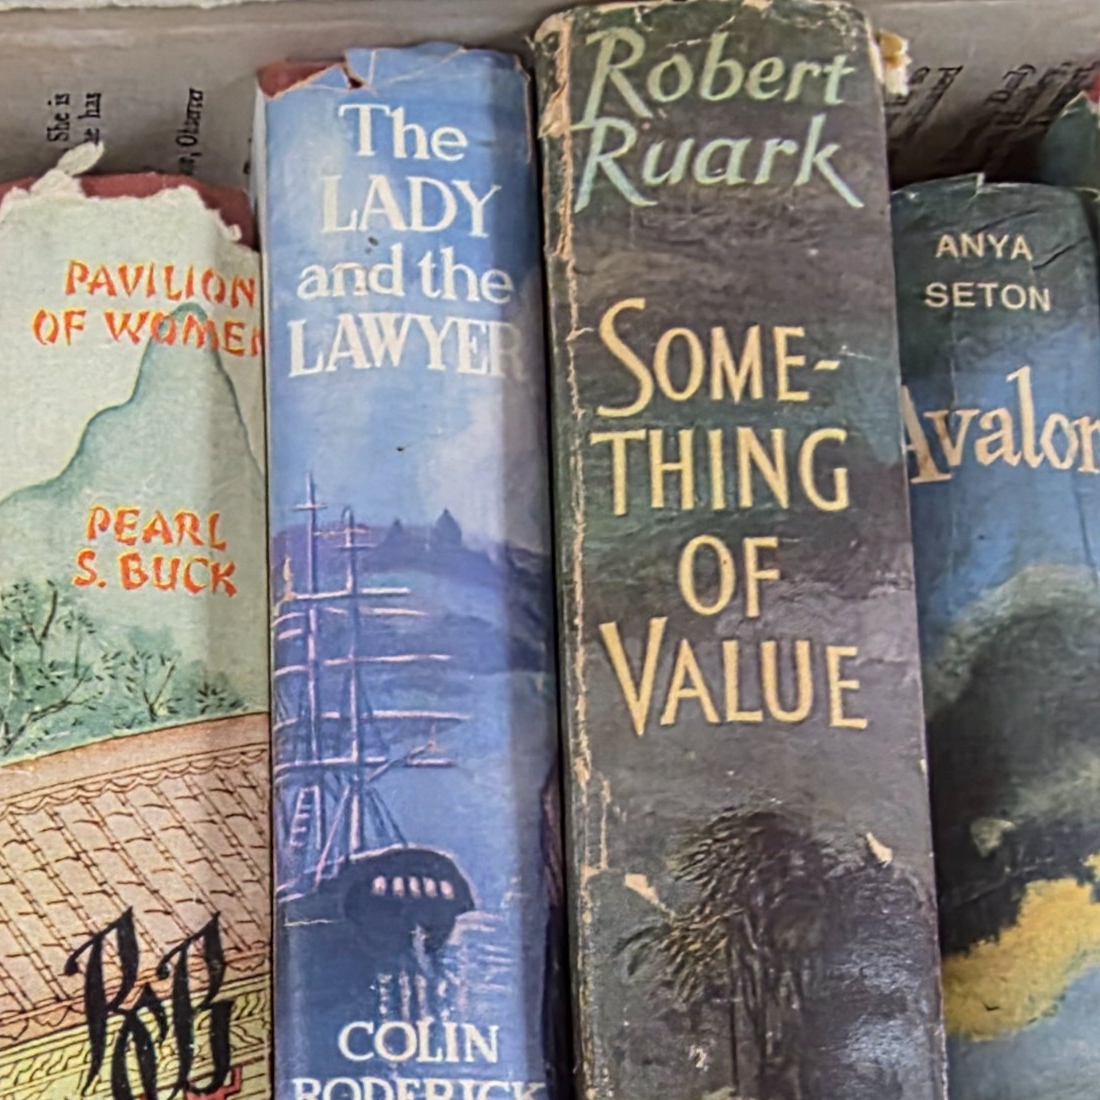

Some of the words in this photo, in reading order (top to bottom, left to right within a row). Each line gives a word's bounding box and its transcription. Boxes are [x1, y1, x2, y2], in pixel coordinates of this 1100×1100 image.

[568, 26, 856, 130] Robert
[46, 112, 70, 142] She
[338, 103, 469, 162] The
[573, 113, 865, 213] Ruark
[319, 174, 502, 238] LADY
[296, 242, 404, 300] and
[417, 246, 514, 304] the
[935, 232, 1033, 262] ANYA
[65, 259, 256, 309] PAVILION
[924, 281, 1051, 313] SETON
[32, 307, 87, 346] OF
[287, 312, 532, 379] LAWYER
[596, 297, 841, 418] SOME-
[590, 427, 850, 516] THING
[86, 504, 227, 552] PEARL
[72, 550, 106, 588] S.
[120, 552, 238, 599] BUCK
[678, 535, 781, 618] OF
[599, 616, 867, 737] VALUE
[337, 1018, 499, 1064] COLIN
